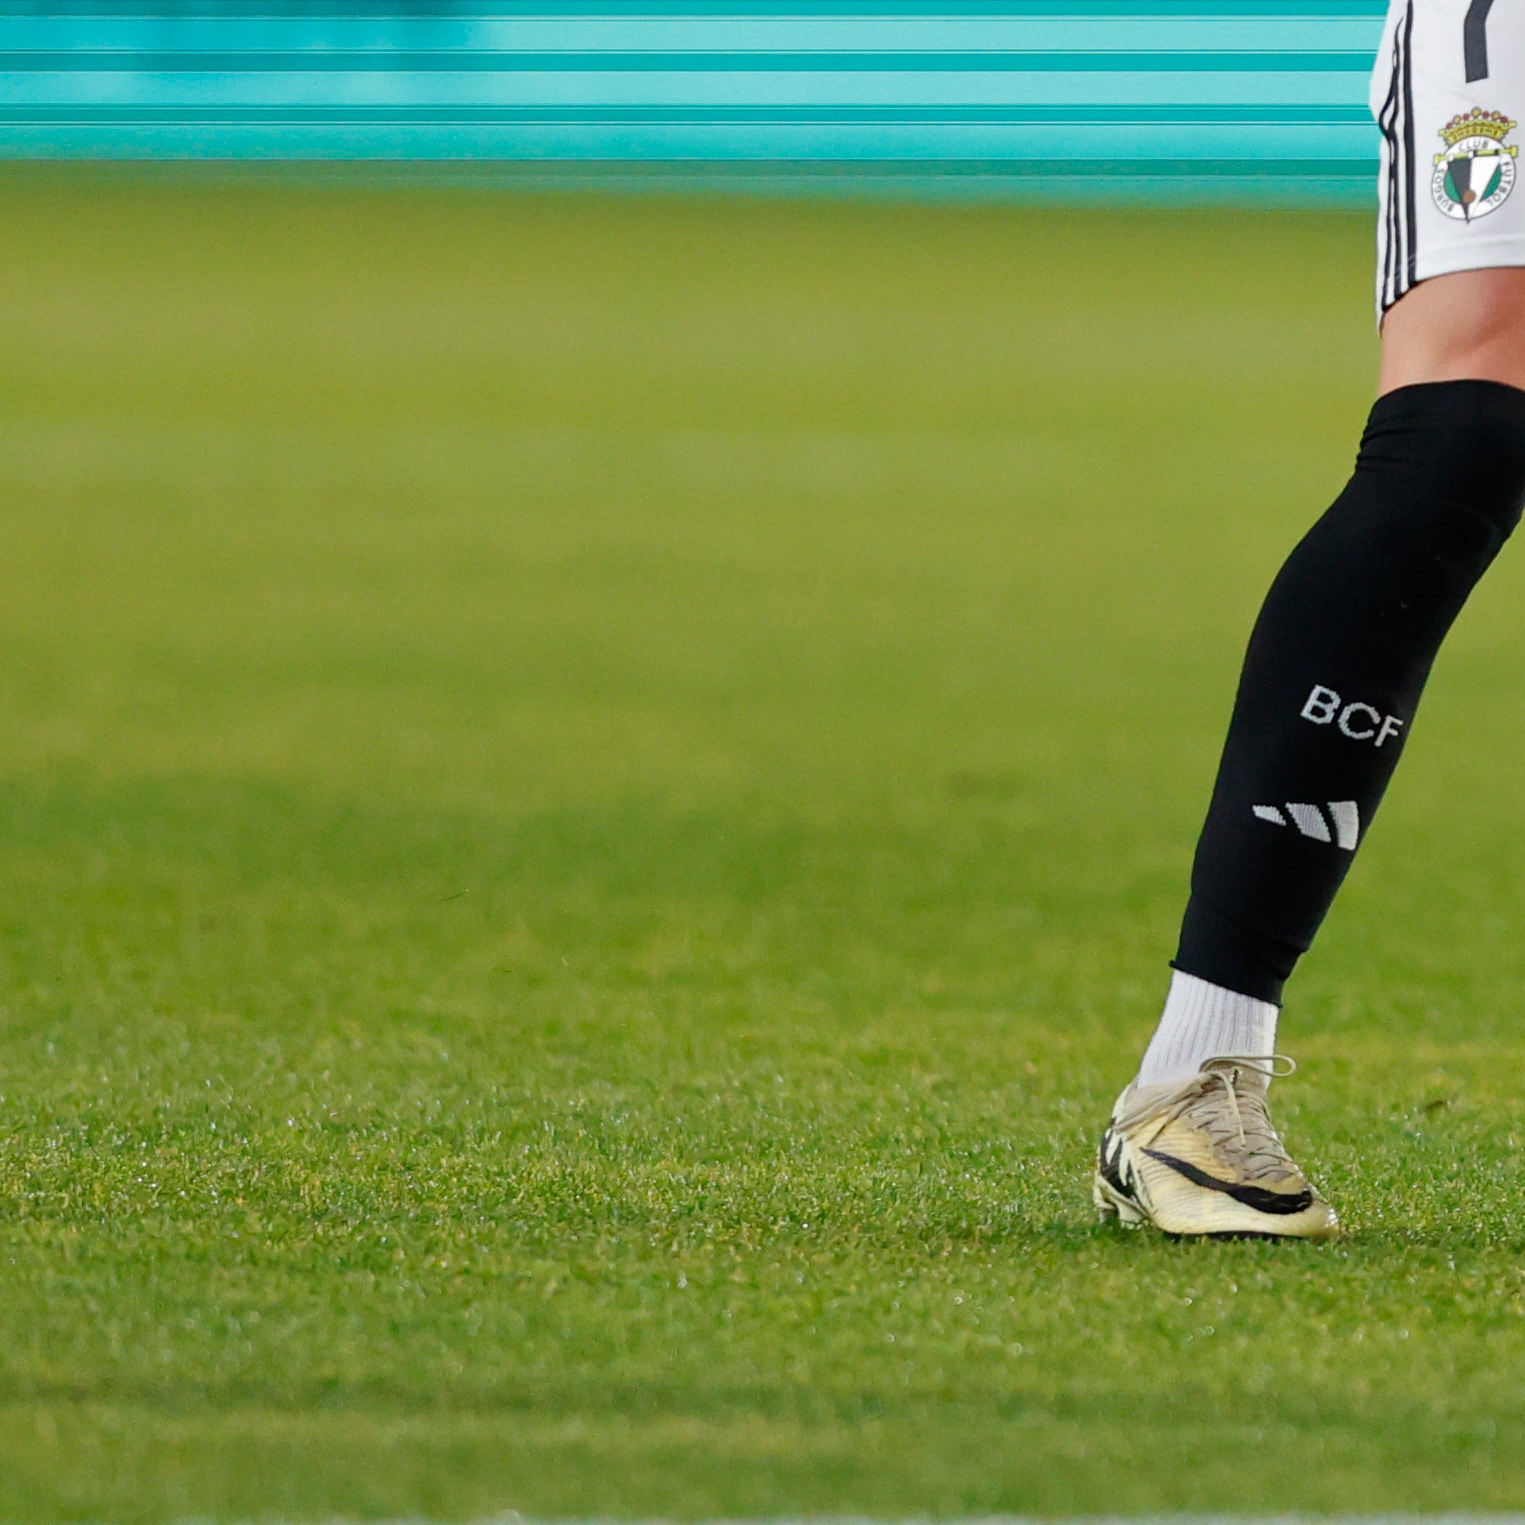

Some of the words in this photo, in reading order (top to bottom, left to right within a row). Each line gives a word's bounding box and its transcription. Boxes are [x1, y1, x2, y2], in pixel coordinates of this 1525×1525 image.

[1458, 139, 1490, 152] CLUB
[1433, 168, 1456, 213] BURGOS
[1485, 160, 1512, 207] FUTBOL
[1300, 684, 1405, 748] BCF
